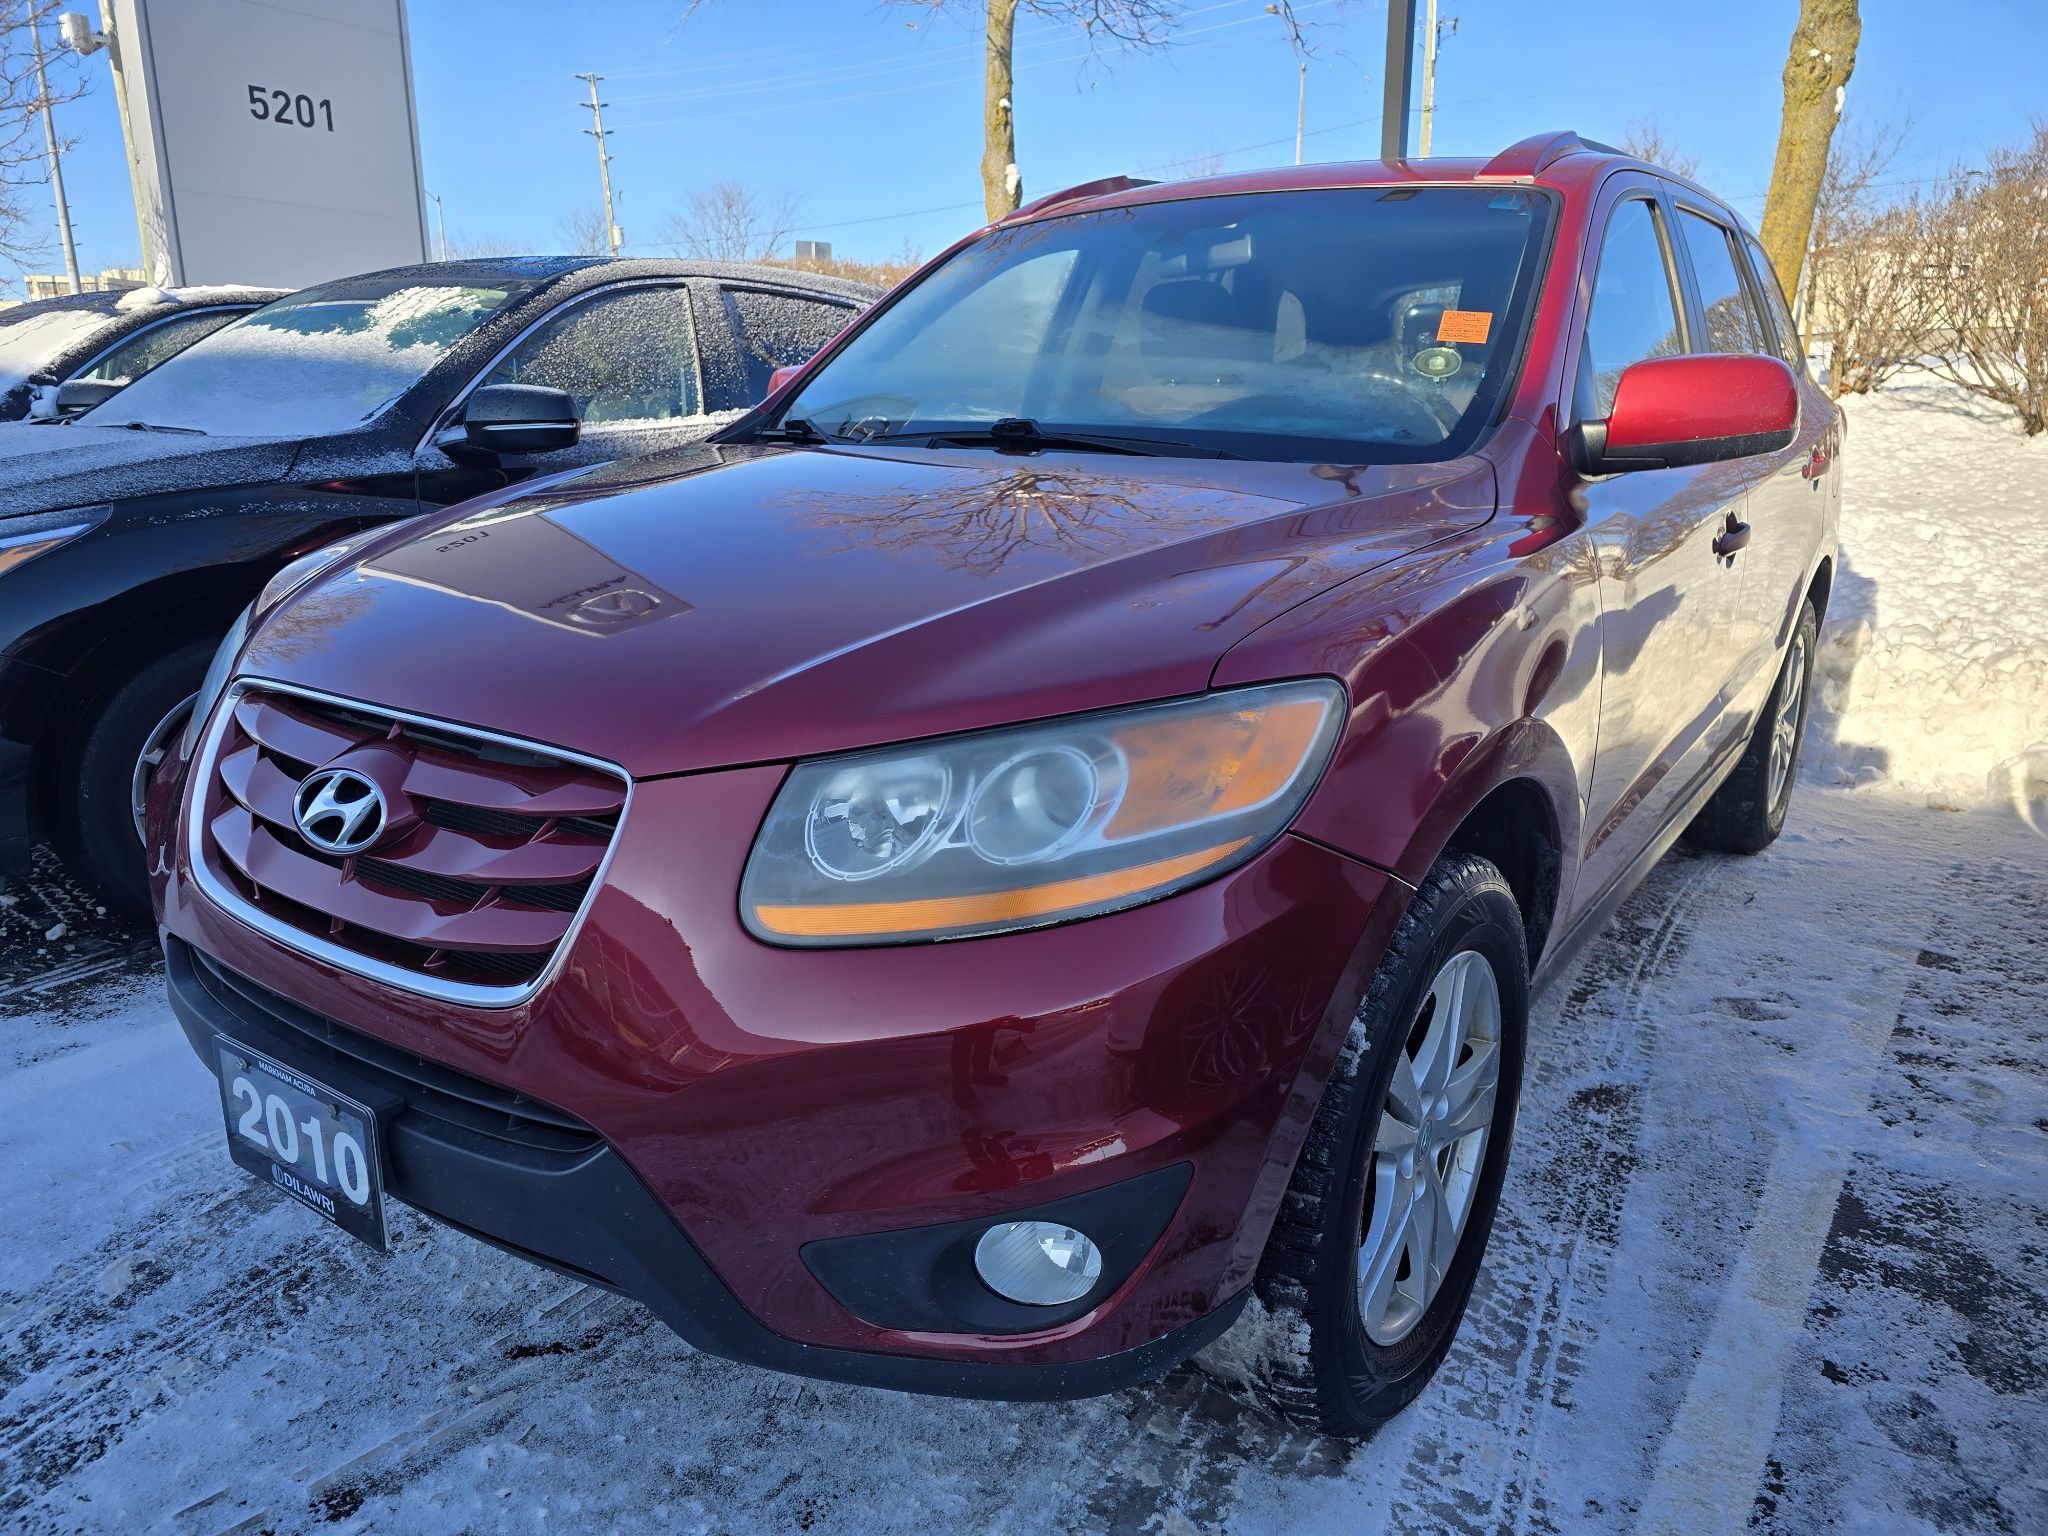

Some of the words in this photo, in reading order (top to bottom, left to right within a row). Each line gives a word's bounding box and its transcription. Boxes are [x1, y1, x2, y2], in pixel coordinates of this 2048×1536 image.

[248, 84, 334, 132] 5201
[258, 1060, 292, 1084] MARKHAM
[293, 1079, 316, 1096] ACURA
[232, 1077, 370, 1206] 2010
[283, 1172, 335, 1214] DILAWRI
